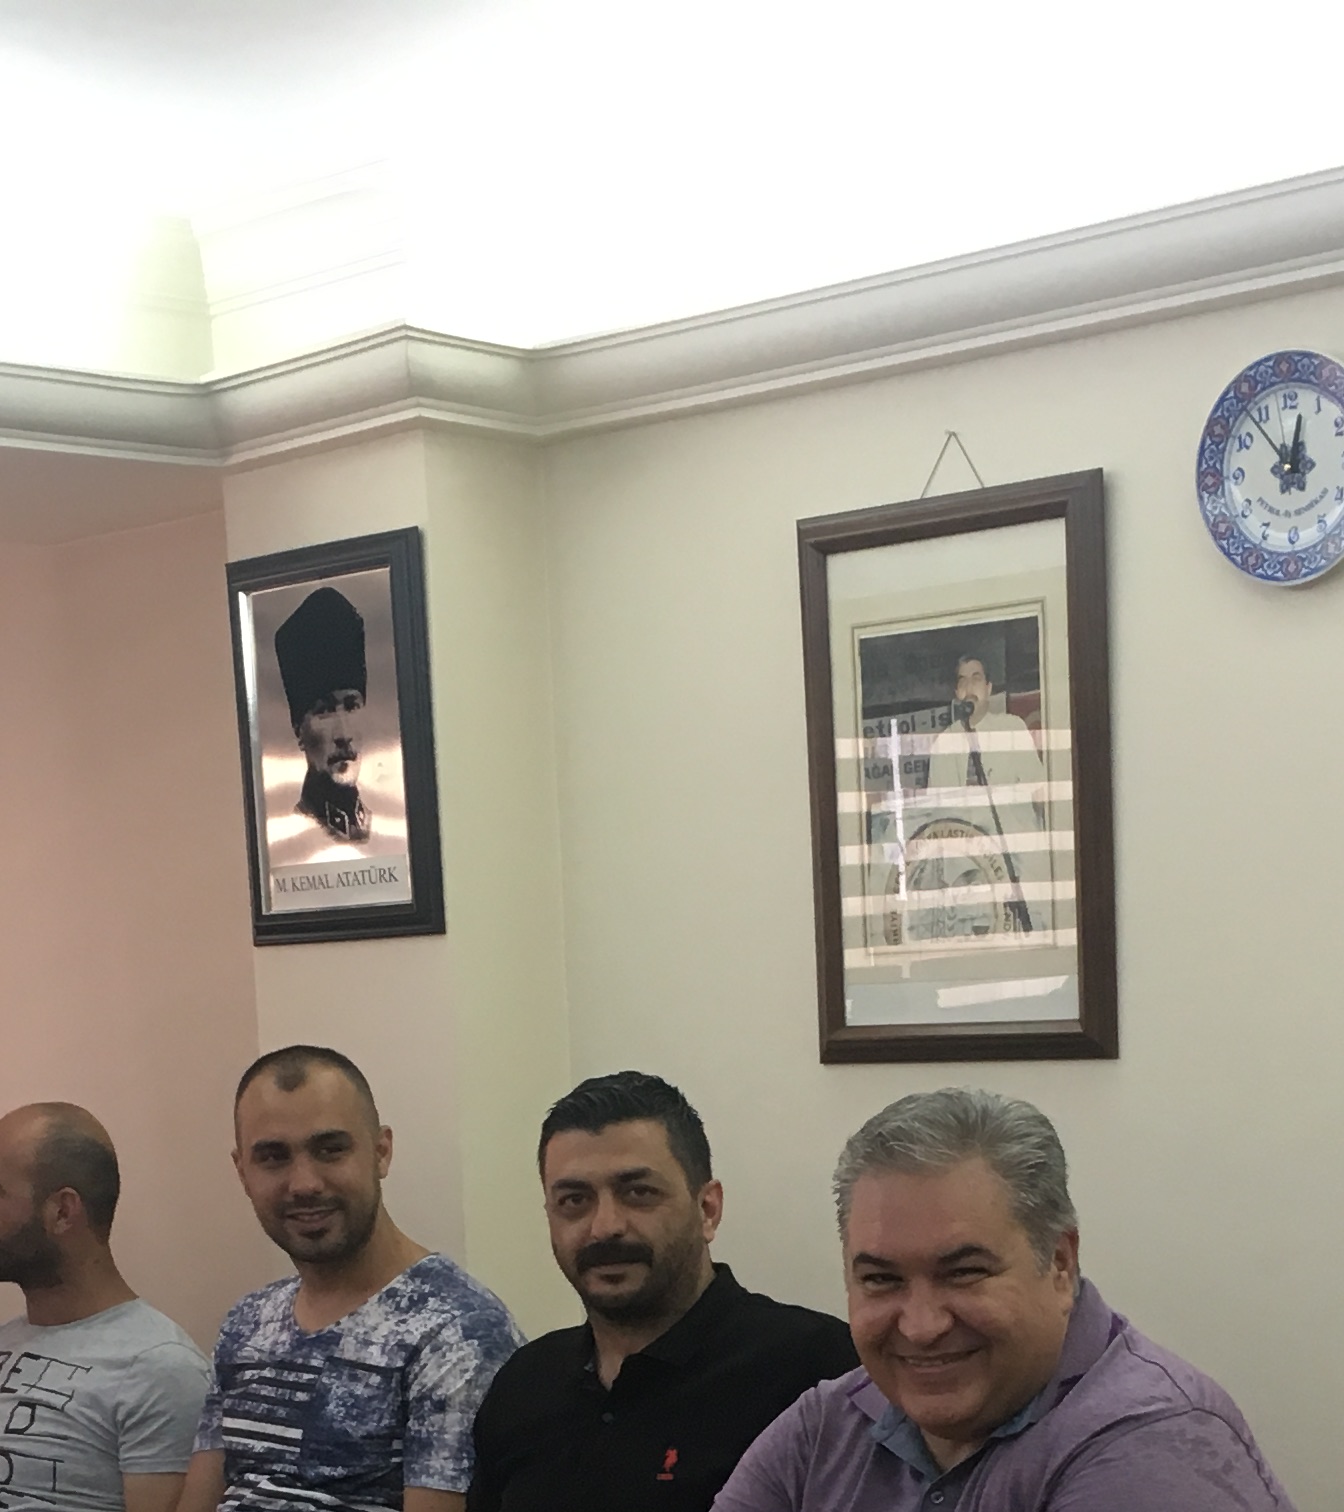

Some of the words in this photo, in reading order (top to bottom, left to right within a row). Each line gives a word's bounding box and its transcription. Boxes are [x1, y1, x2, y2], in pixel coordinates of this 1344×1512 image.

[1282, 391, 1298, 411] 12
[1314, 396, 1322, 415] 1
[1256, 405, 1270, 424] 11
[1334, 417, 1344, 437] 2
[1236, 432, 1254, 452] 10
[1232, 467, 1245, 486] 9
[1241, 498, 1252, 519] 8
[1260, 521, 1271, 540] 7
[1317, 513, 1327, 532] 5
[1288, 526, 1300, 545] 6
[291, 873, 334, 892] KEMAL
[336, 866, 399, 889] ATATÜRK
